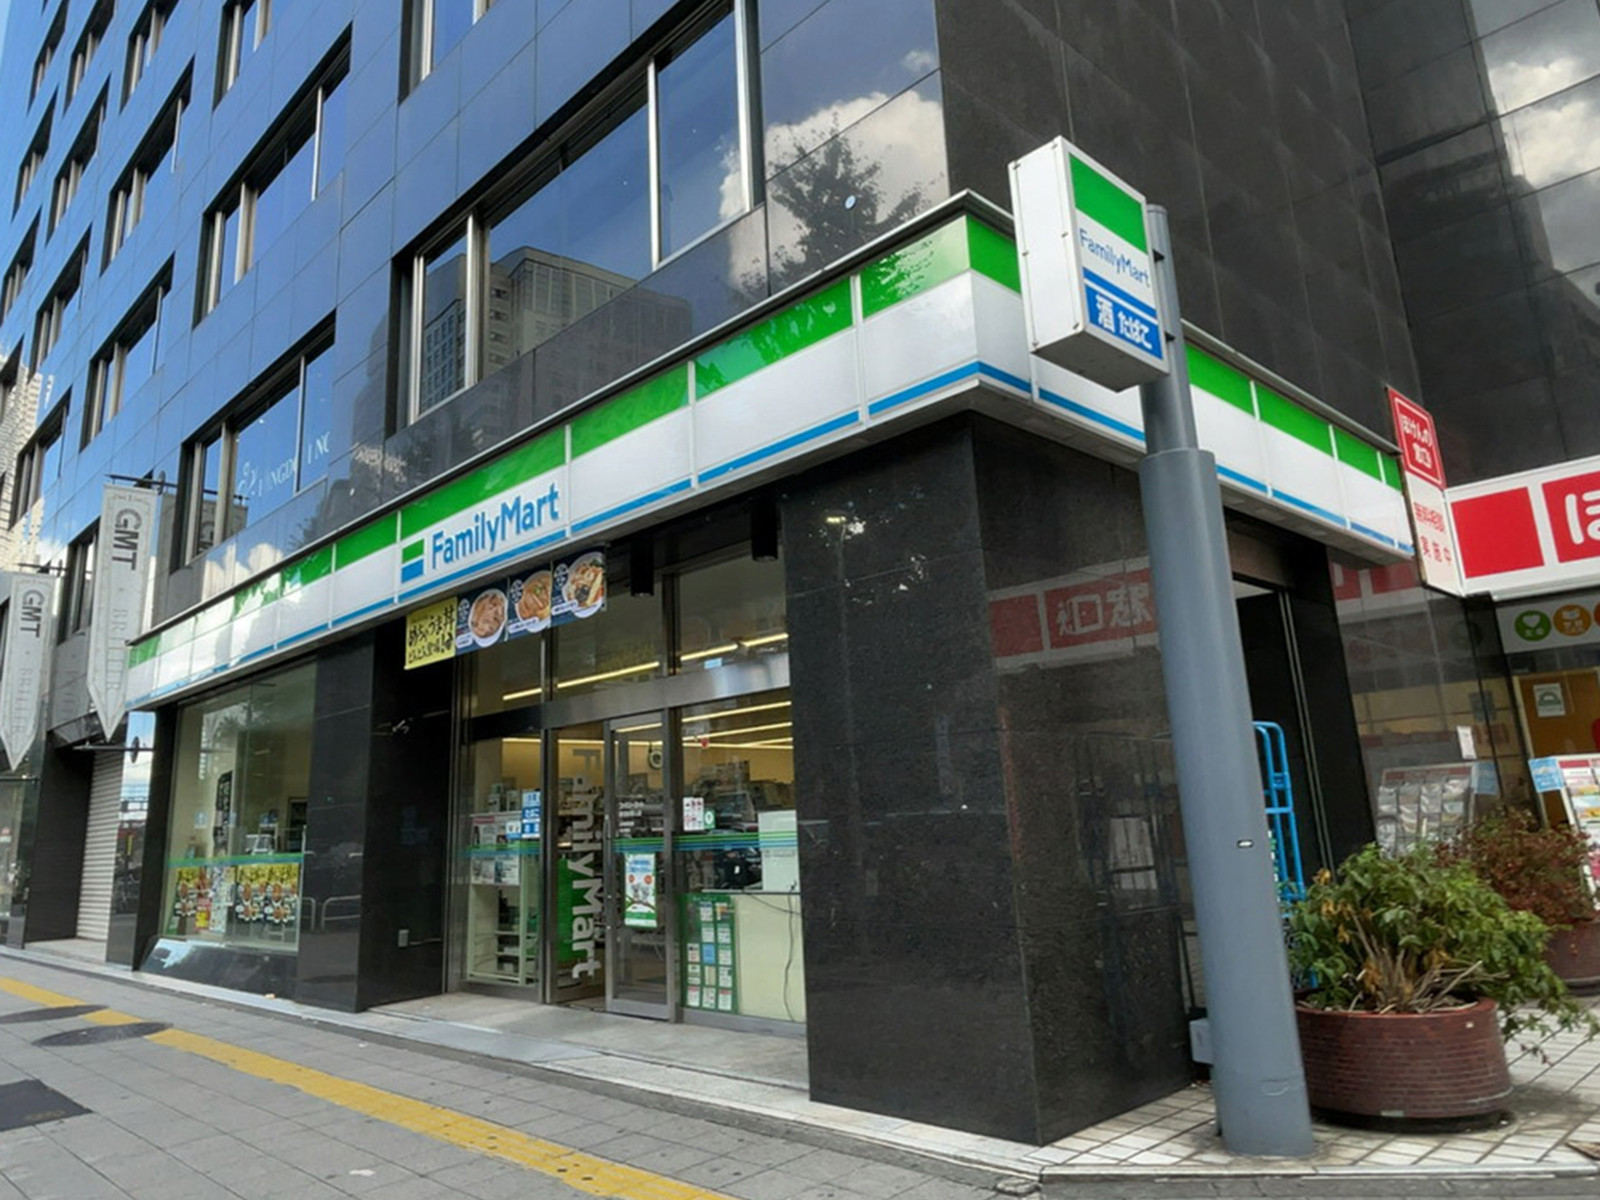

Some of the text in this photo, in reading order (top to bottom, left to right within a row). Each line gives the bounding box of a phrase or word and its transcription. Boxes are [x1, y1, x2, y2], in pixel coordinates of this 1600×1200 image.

[1079, 228, 1150, 288] FamilyMart
[1096, 294, 1116, 334] 酒
[111, 507, 143, 572] GMT
[431, 482, 560, 570] FamilyMart
[19, 588, 45, 639] GMT
[567, 748, 603, 980] FamilyMart
